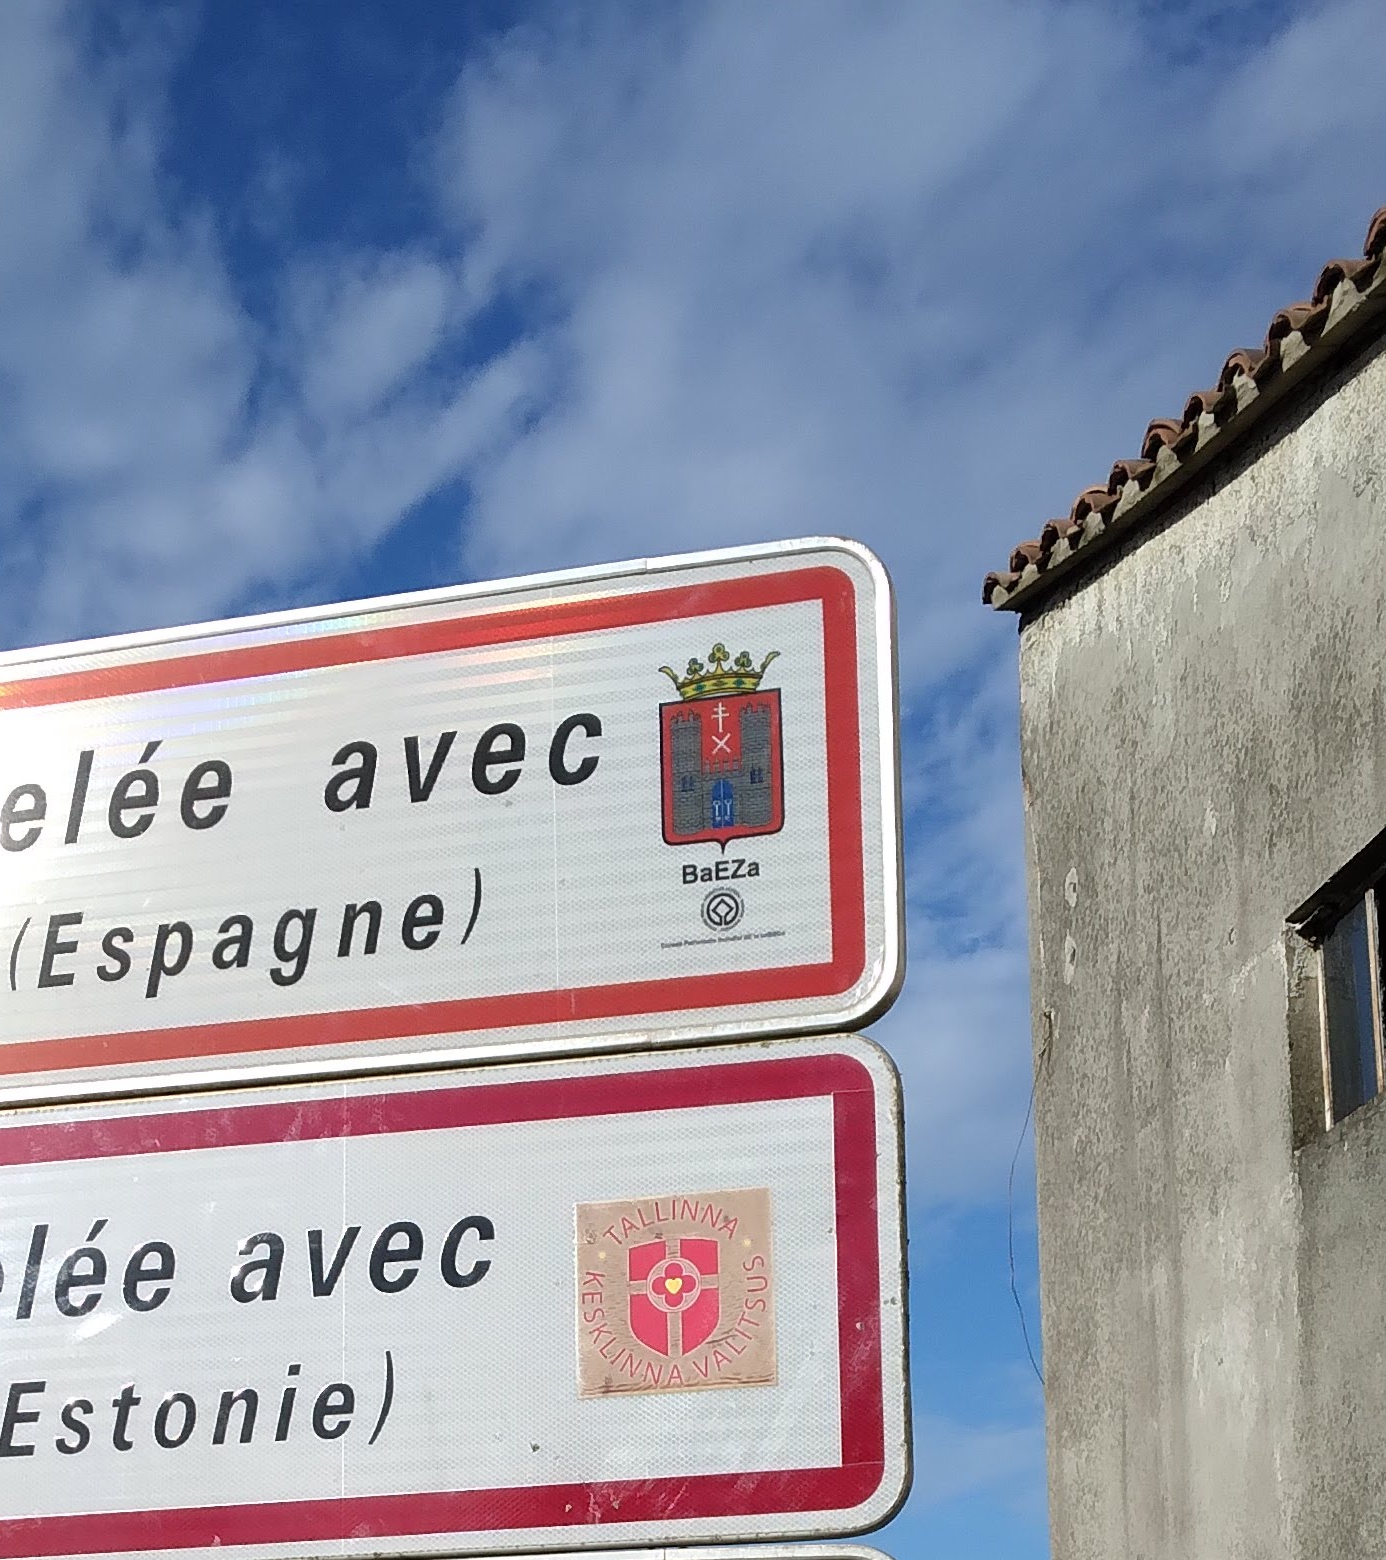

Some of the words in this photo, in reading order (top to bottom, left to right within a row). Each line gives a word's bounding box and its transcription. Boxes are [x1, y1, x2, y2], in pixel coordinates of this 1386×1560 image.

[324, 711, 604, 813] avec
[9, 867, 482, 998] (Espagne)
[229, 1214, 496, 1305] avec
[603, 1199, 739, 1246] TALLINNA
[581, 1270, 684, 1385] KESKLINNA
[692, 1255, 768, 1378] VALITSUS
